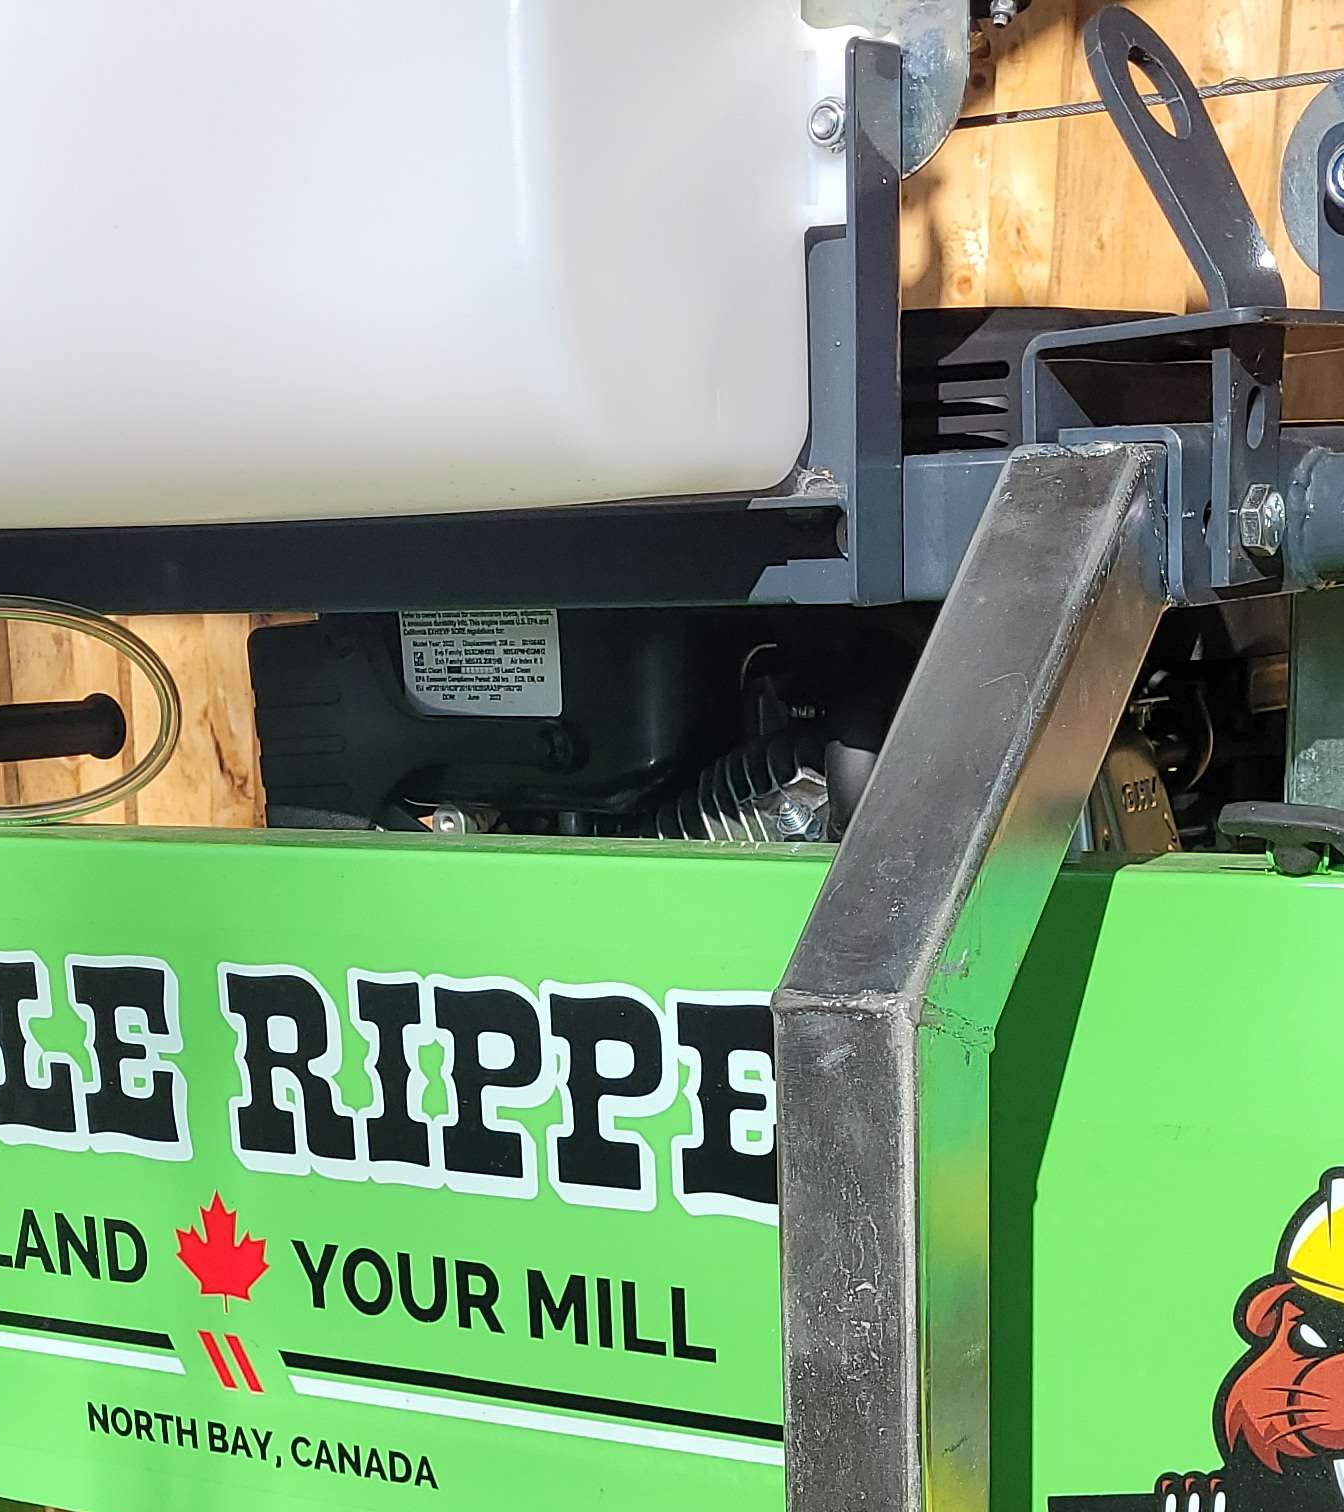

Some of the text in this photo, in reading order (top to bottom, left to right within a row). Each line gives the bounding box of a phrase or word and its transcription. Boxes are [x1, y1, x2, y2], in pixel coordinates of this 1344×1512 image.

[291, 1239, 717, 1363] YOUR MILL
[87, 1402, 438, 1489] NORTH BAY, CANADA
